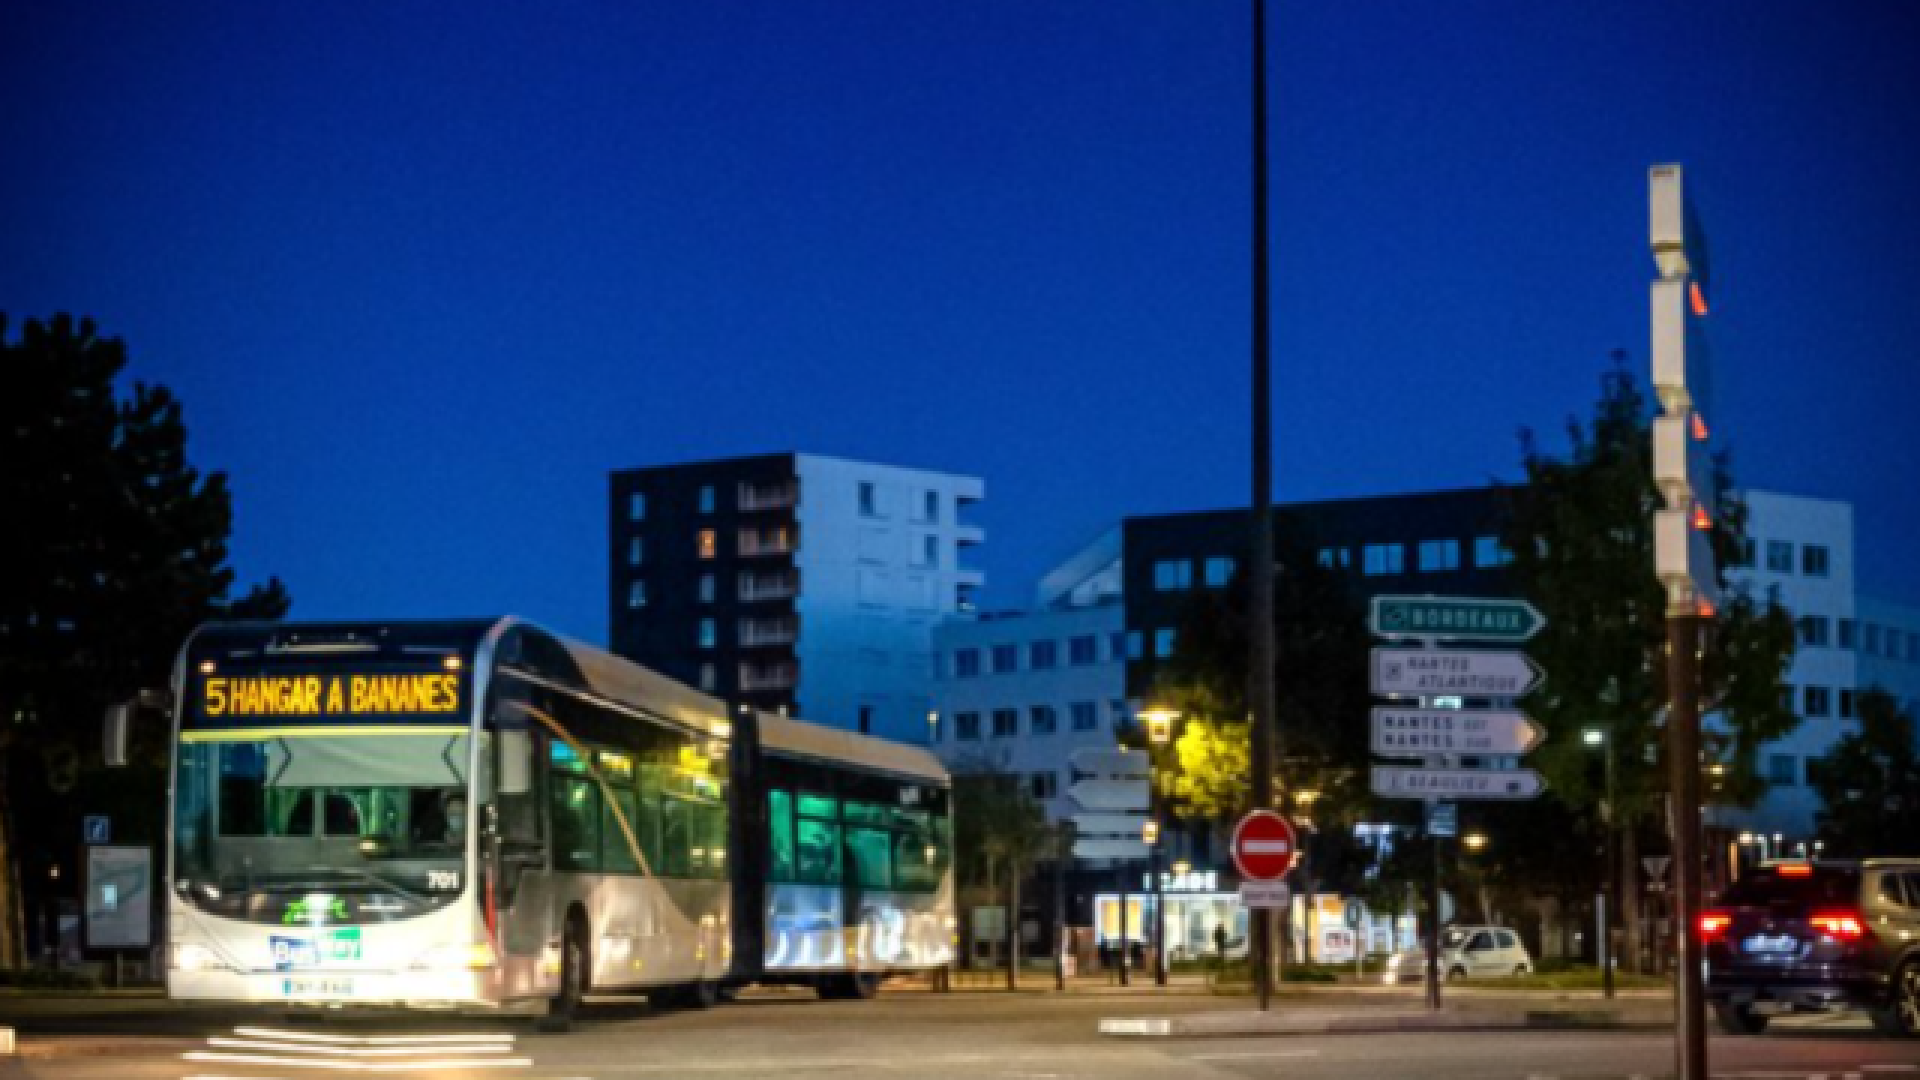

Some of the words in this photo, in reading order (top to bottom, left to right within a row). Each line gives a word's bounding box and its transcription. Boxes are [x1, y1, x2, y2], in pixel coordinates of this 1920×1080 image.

[1411, 607, 1521, 629] BORDEAUX
[1406, 656, 1470, 672] NANTES
[1416, 674, 1518, 691] ATLANTIQUE
[204, 677, 226, 715] 5
[230, 677, 321, 714] HANGAR
[350, 674, 460, 713] BANANES
[1384, 714, 1453, 730] NANTES
[1384, 732, 1453, 747] NANTES
[1407, 774, 1489, 790] BEAULIEU
[427, 869, 460, 888] 701
